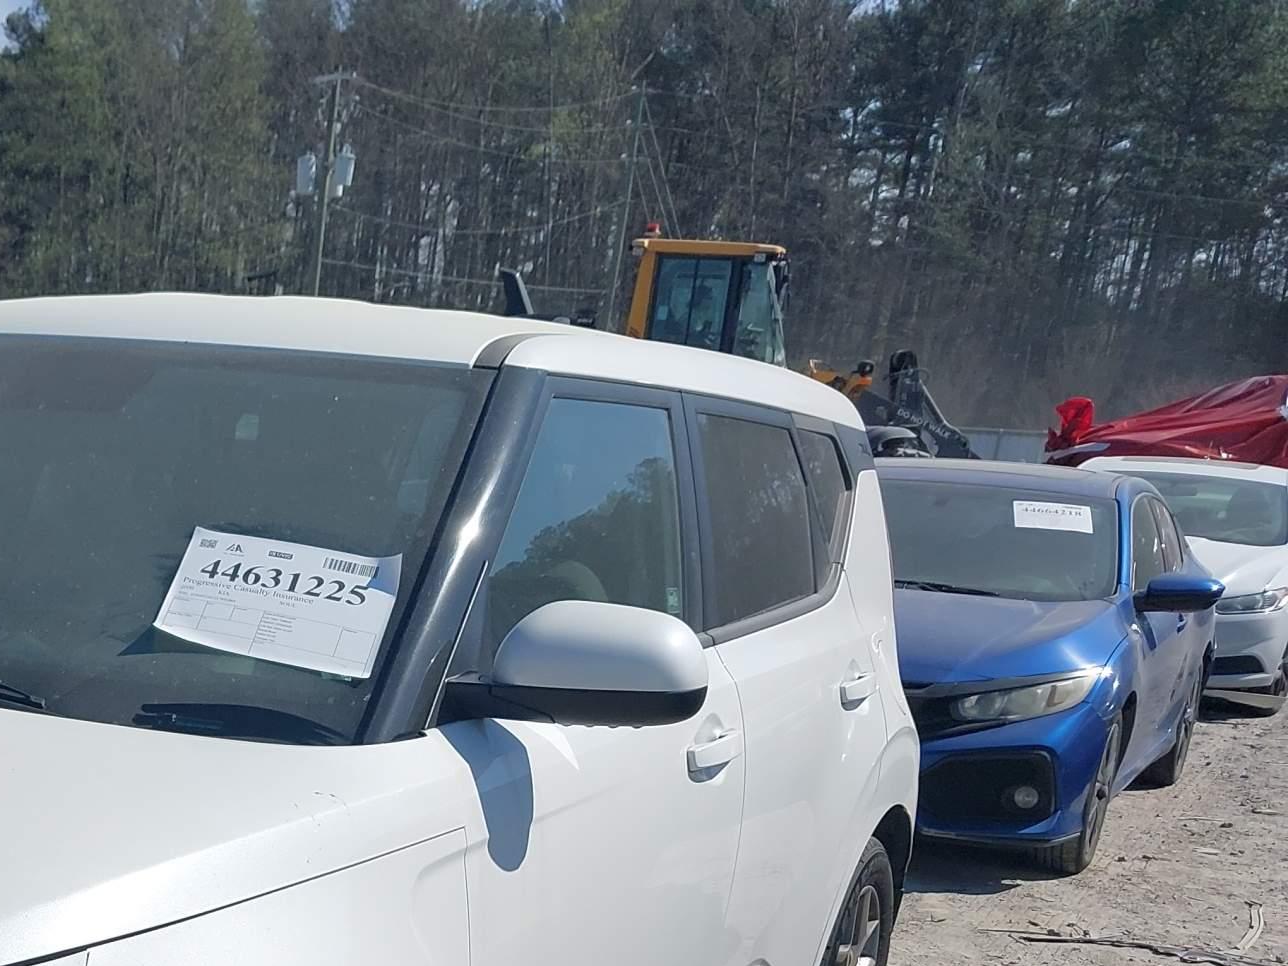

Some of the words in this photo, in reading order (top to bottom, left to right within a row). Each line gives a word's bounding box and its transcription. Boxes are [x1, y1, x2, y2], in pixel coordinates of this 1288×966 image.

[183, 577, 232, 590] Progressive
[233, 583, 270, 597] Casualty
[272, 590, 315, 604] Insurance
[200, 559, 369, 606] 44631225
